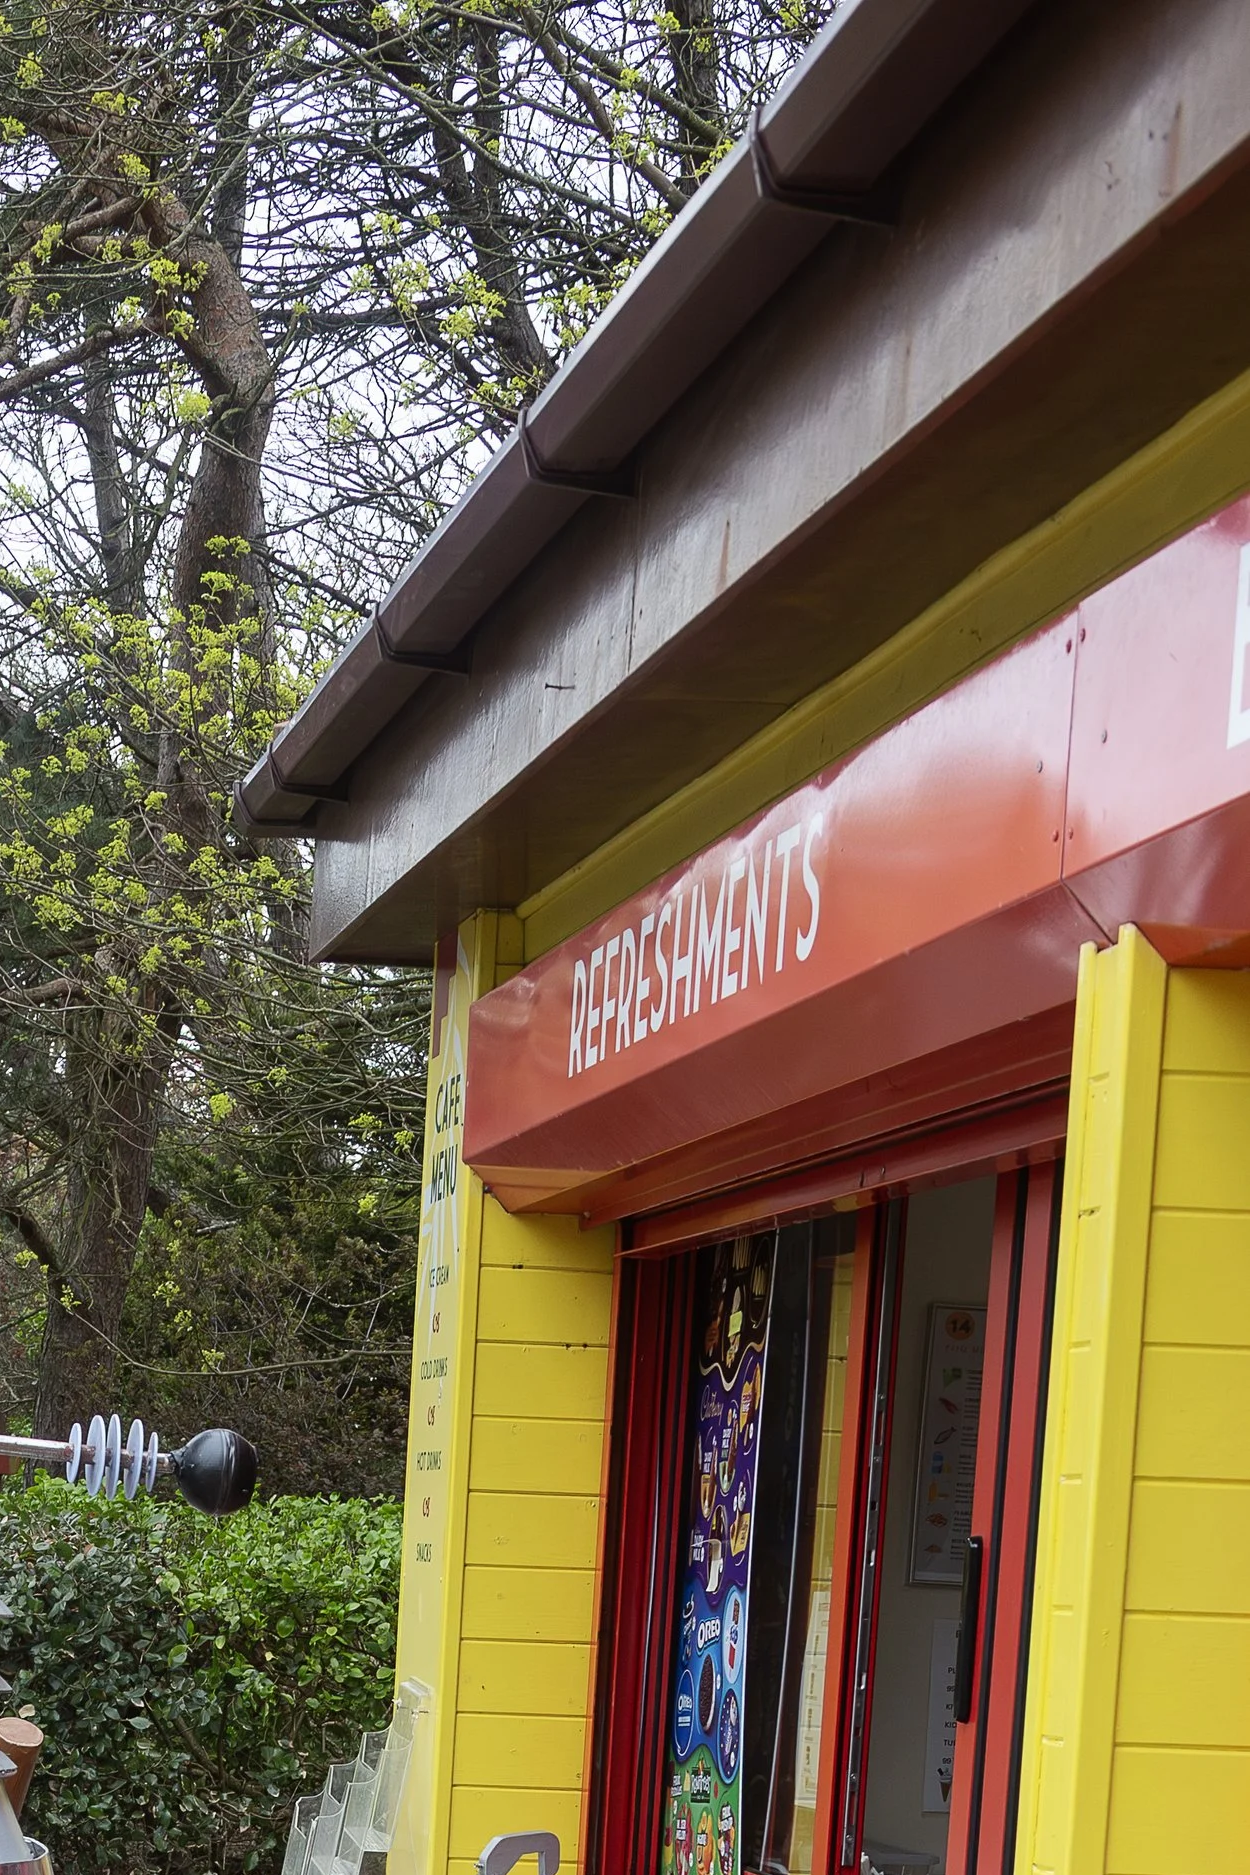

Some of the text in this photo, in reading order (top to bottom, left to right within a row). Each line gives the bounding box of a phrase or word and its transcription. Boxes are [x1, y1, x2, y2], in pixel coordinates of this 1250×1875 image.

[567, 811, 824, 1079] REFRESHMENTS
[435, 1073, 462, 1134] CAFE
[430, 1143, 458, 1205] MENU
[950, 1319, 971, 1334] 14
[420, 1357, 448, 1381] COLD DRINKS
[700, 1384, 724, 1426] Cadbury
[416, 1450, 442, 1471] HOT DRINKS
[416, 1543, 432, 1562] SNACKS
[697, 1617, 721, 1649] OREO
